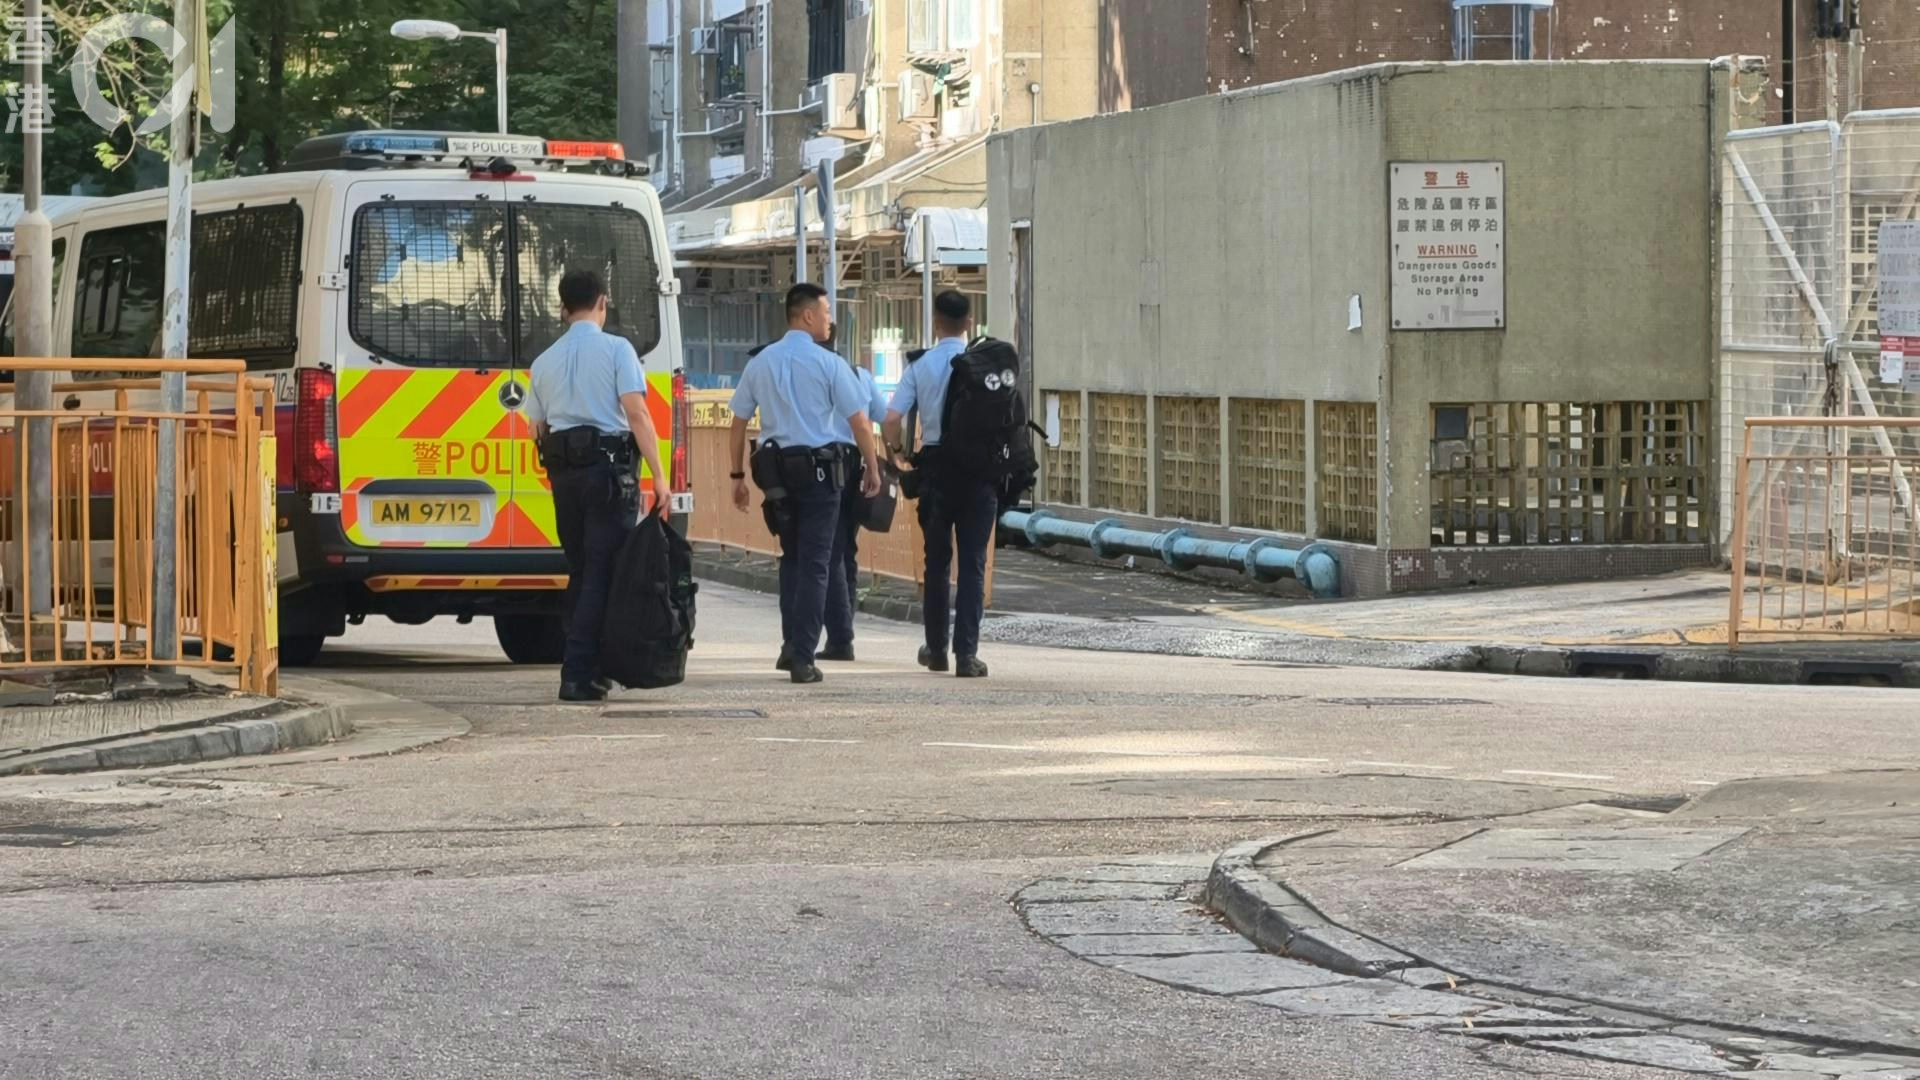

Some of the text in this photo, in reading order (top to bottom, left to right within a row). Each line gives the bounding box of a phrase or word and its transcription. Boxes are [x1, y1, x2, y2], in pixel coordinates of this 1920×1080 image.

[472, 142, 519, 154] POLICE
[1424, 171, 1469, 186] 警告
[1397, 218, 1498, 232] 嚴禁違例停泊
[1418, 244, 1477, 255] WARNING
[1398, 260, 1497, 271] Dangerous Goods
[1411, 273, 1484, 284] Storage Area
[1417, 286, 1479, 297] No Parking
[413, 442, 548, 475] 警 POLIC
[381, 503, 472, 522] AM 9712
